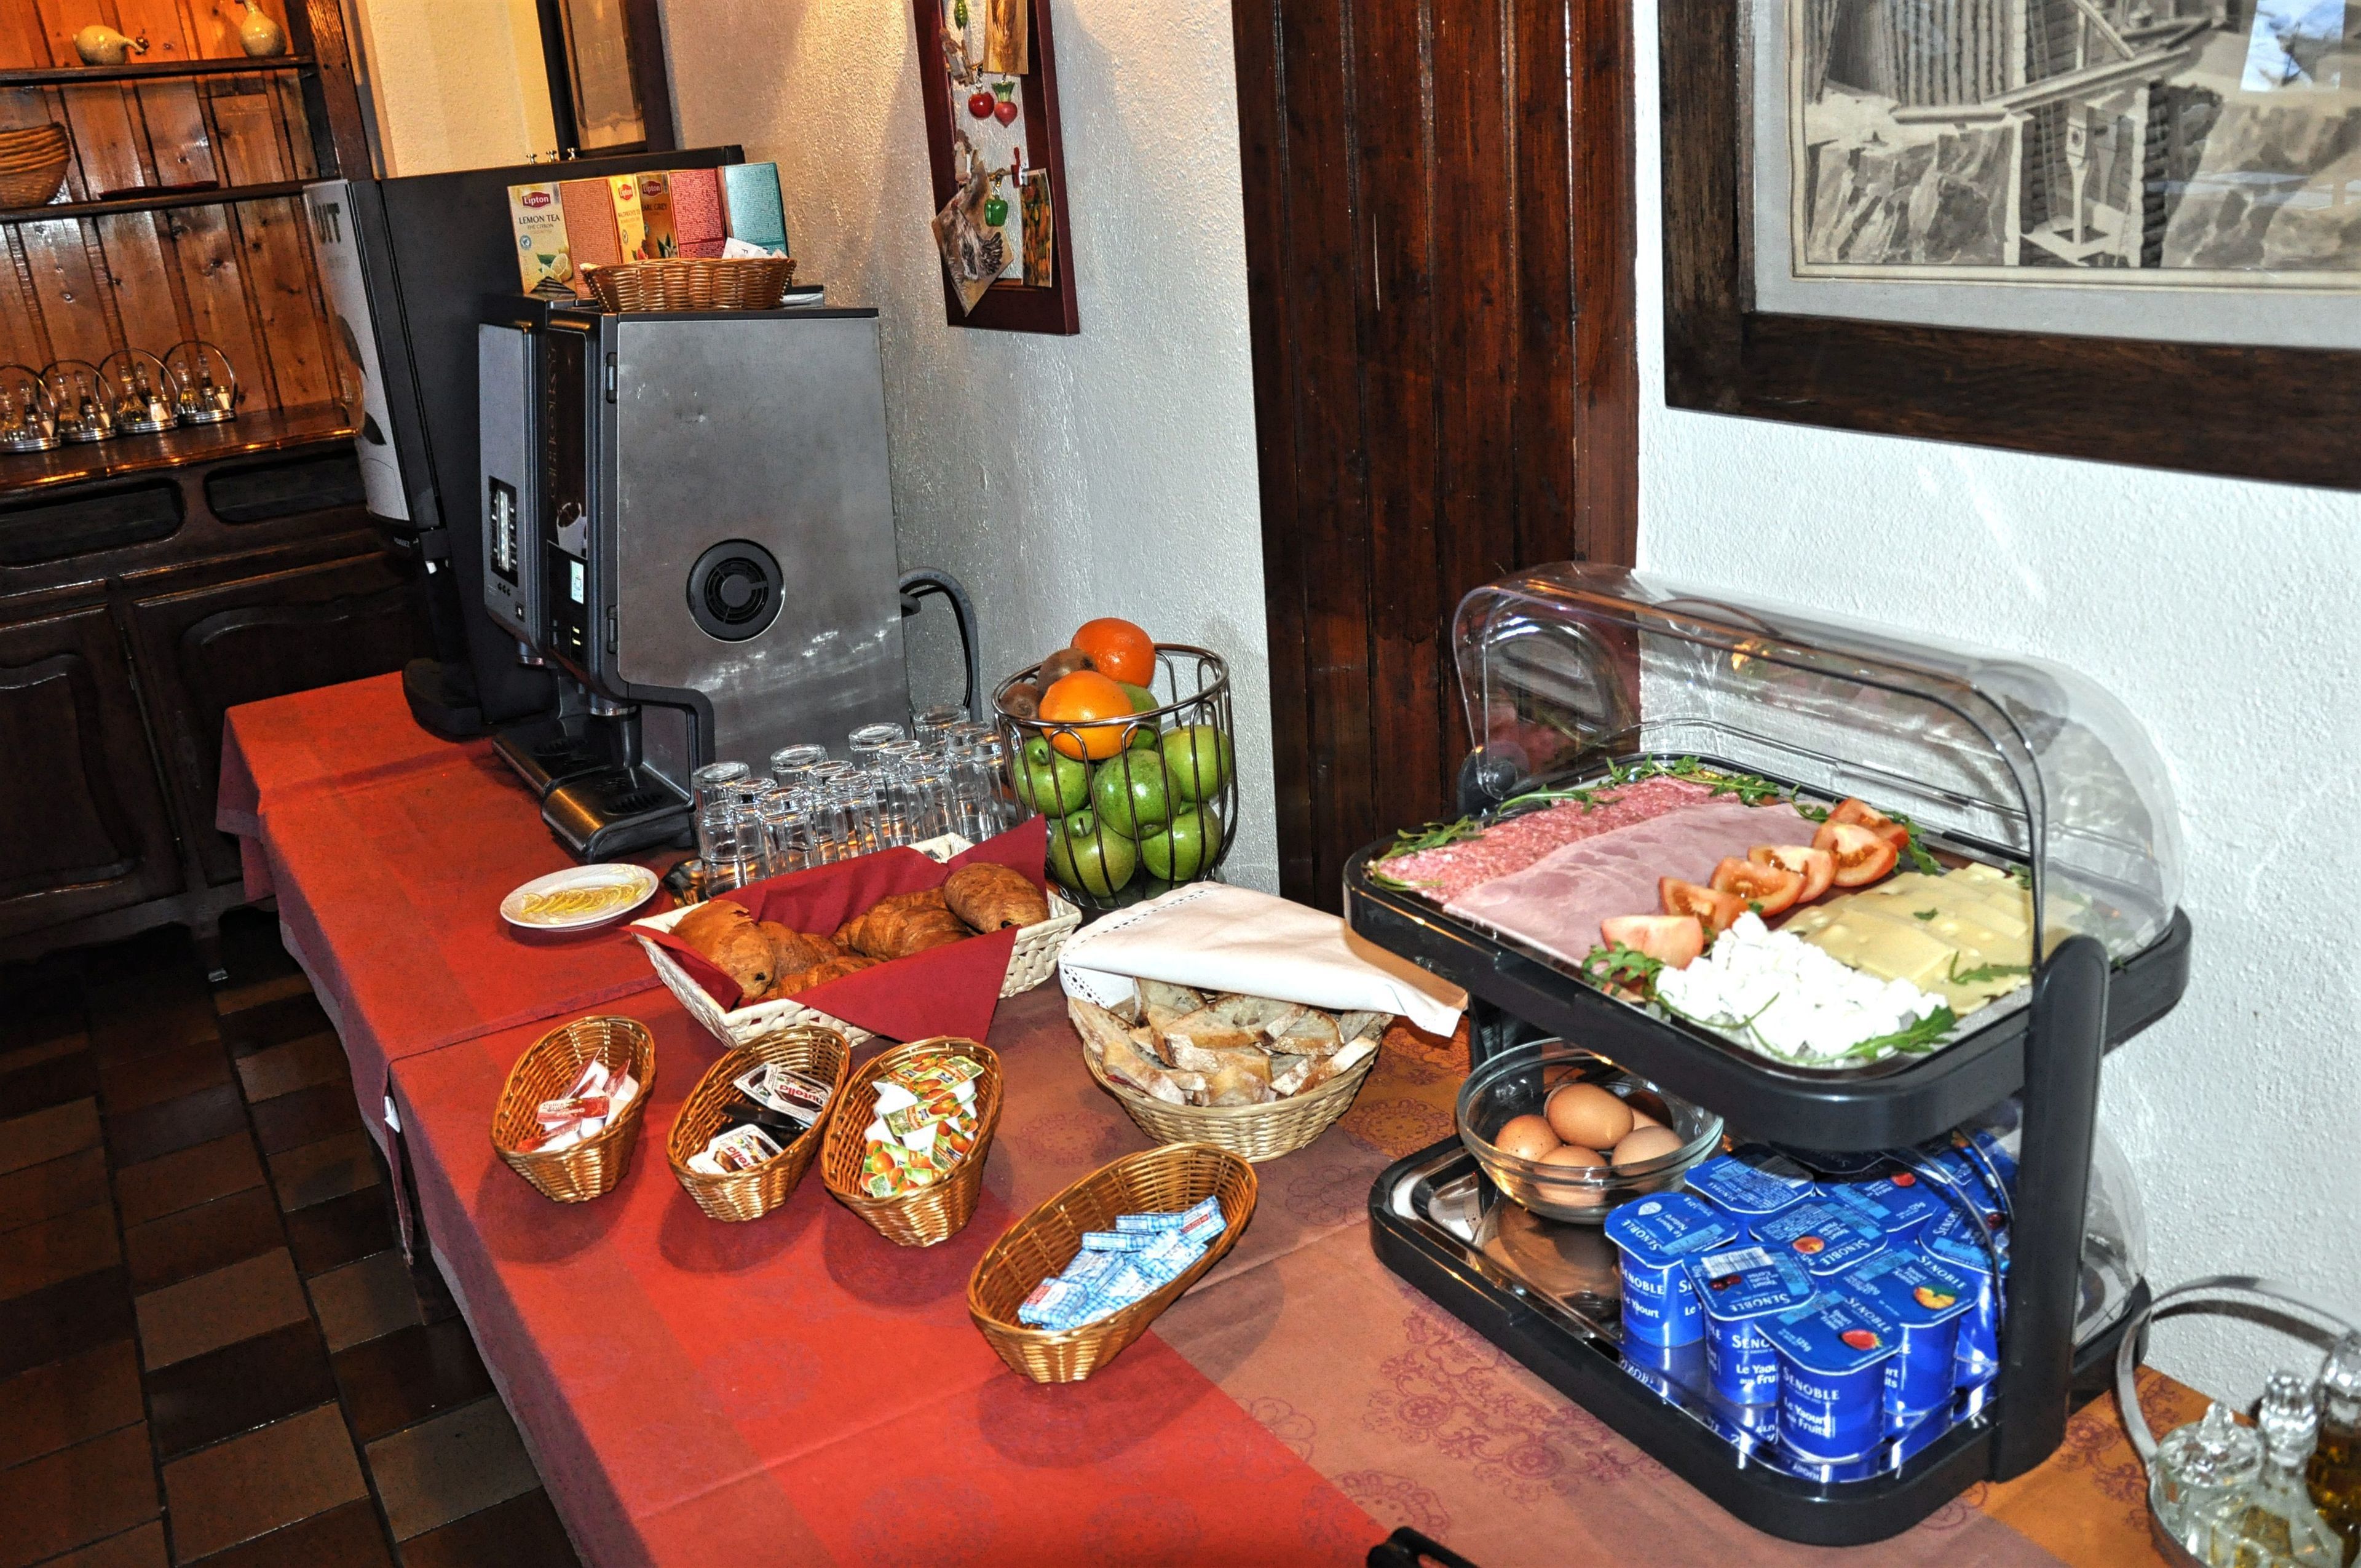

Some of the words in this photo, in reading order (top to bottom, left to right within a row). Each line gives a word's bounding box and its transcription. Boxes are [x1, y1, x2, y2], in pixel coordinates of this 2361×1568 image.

[524, 196, 549, 206] Lipton
[312, 202, 341, 244] UIT
[518, 215, 545, 224] LEMON
[780, 1084, 823, 1105] nutella
[727, 1146, 752, 1168] tella
[1621, 1219, 1661, 1251] SENOBLE
[1819, 1239, 1870, 1265] SENOBLE
[1620, 1262, 1665, 1295] SENOBLE
[1918, 1255, 1967, 1289] SENOBLE
[1632, 1299, 1659, 1318] Yaourt
[1685, 1306, 1696, 1316] Le
[1729, 1293, 1790, 1312] SENOBLE
[1844, 1297, 1894, 1333] SENOBLE
[1732, 1334, 1770, 1348] SENO
[1736, 1364, 1750, 1374] Le
[1752, 1364, 1776, 1374] Yaou
[1757, 1374, 1776, 1385] Fru
[1784, 1367, 1840, 1400] SENOBLE
[1794, 1406, 1826, 1424] Yaourt
[1798, 1418, 1830, 1437] Fruits
